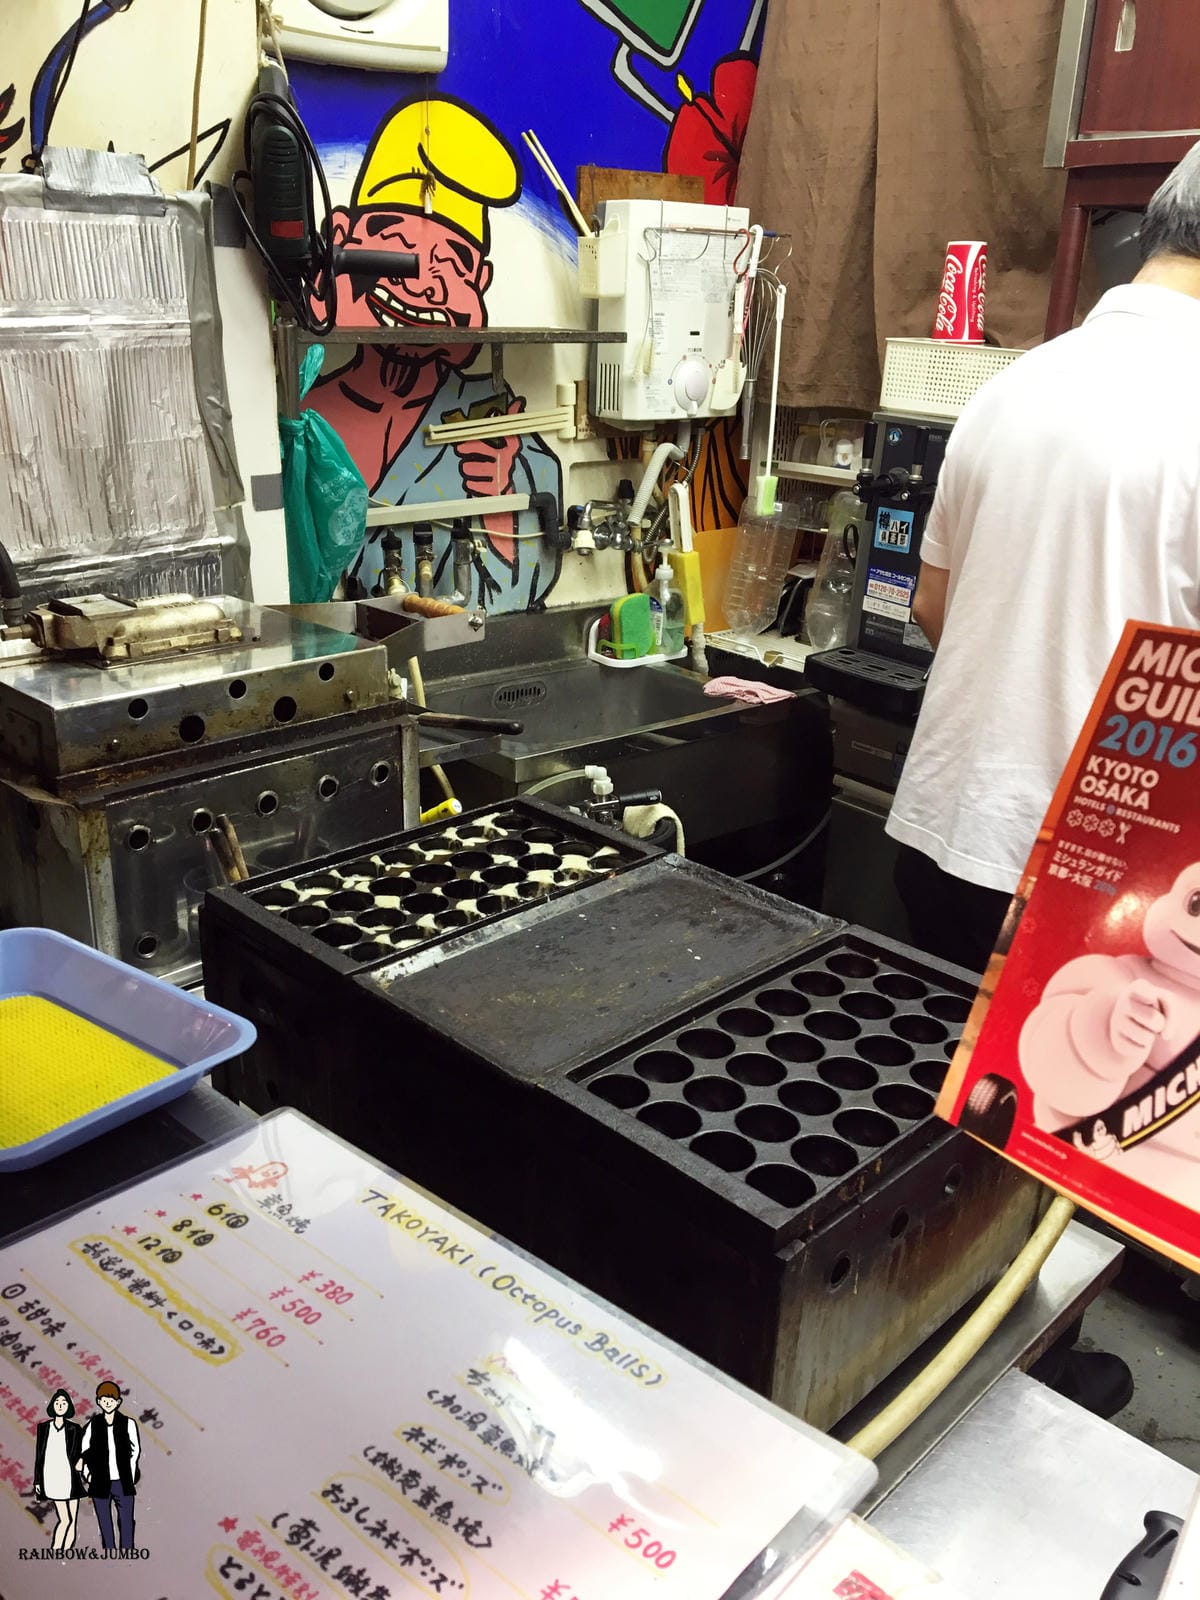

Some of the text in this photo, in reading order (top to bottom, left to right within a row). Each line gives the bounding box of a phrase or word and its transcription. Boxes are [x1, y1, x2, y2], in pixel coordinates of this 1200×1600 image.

[1099, 714, 1198, 768] 2016
[1086, 755, 1159, 789] KYOTO
[1080, 775, 1150, 810] OSAKA
[1073, 795, 1106, 812] HOTELS
[1115, 807, 1181, 834] RESTAURANTS
[1052, 850, 1125, 882] ミシュランガイド
[269, 1286, 323, 1325] ¥500
[298, 1270, 354, 1305] ¥380
[362, 1189, 663, 1386] TAKOYAKI (Octopus Balls)
[232, 1307, 286, 1348] ¥760
[608, 1513, 677, 1569] ¥500
